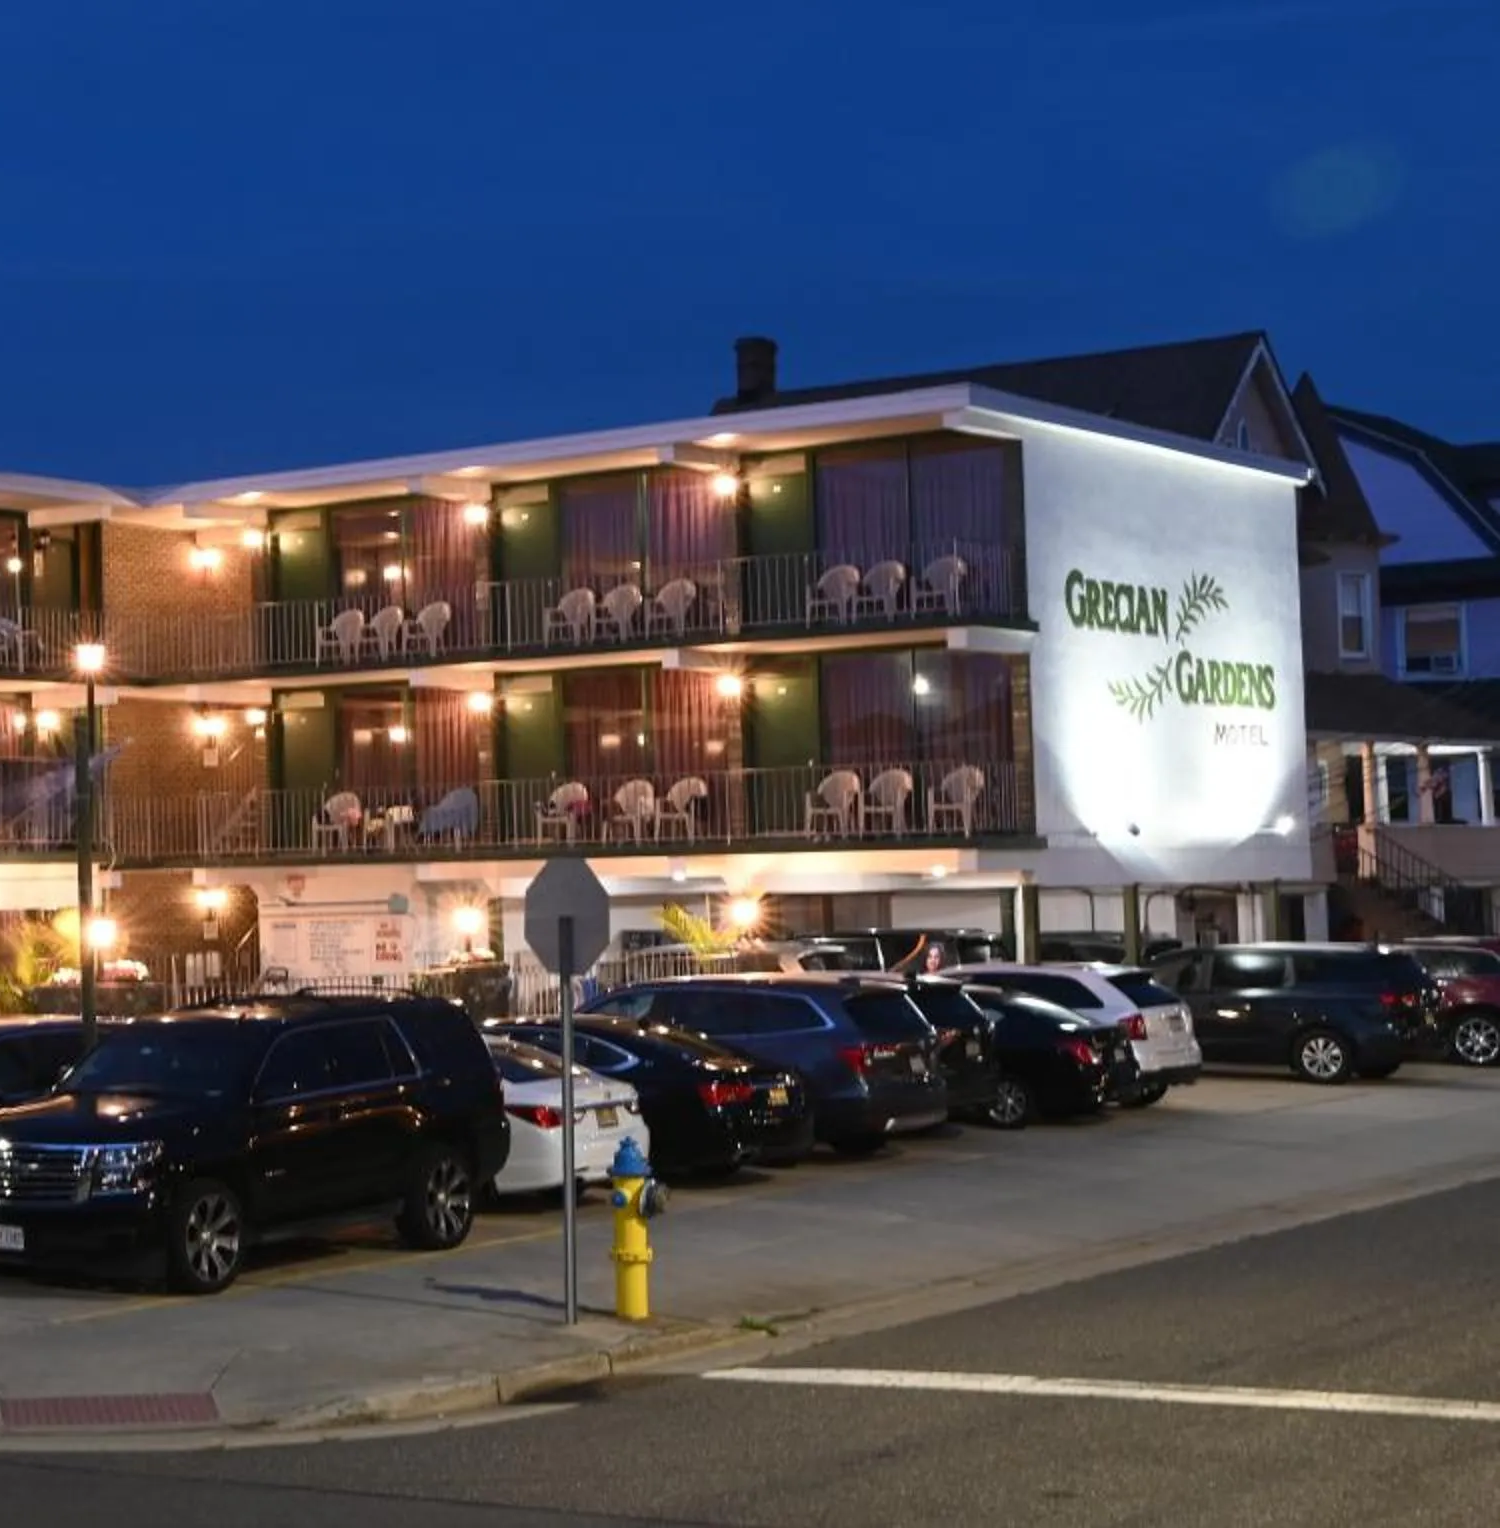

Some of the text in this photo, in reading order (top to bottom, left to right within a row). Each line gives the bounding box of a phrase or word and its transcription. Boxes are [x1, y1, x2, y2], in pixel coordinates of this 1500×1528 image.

[1064, 568, 1168, 643] GRECIAN
[1175, 650, 1275, 711] GARDENS
[1213, 722, 1269, 746] MOTEL
